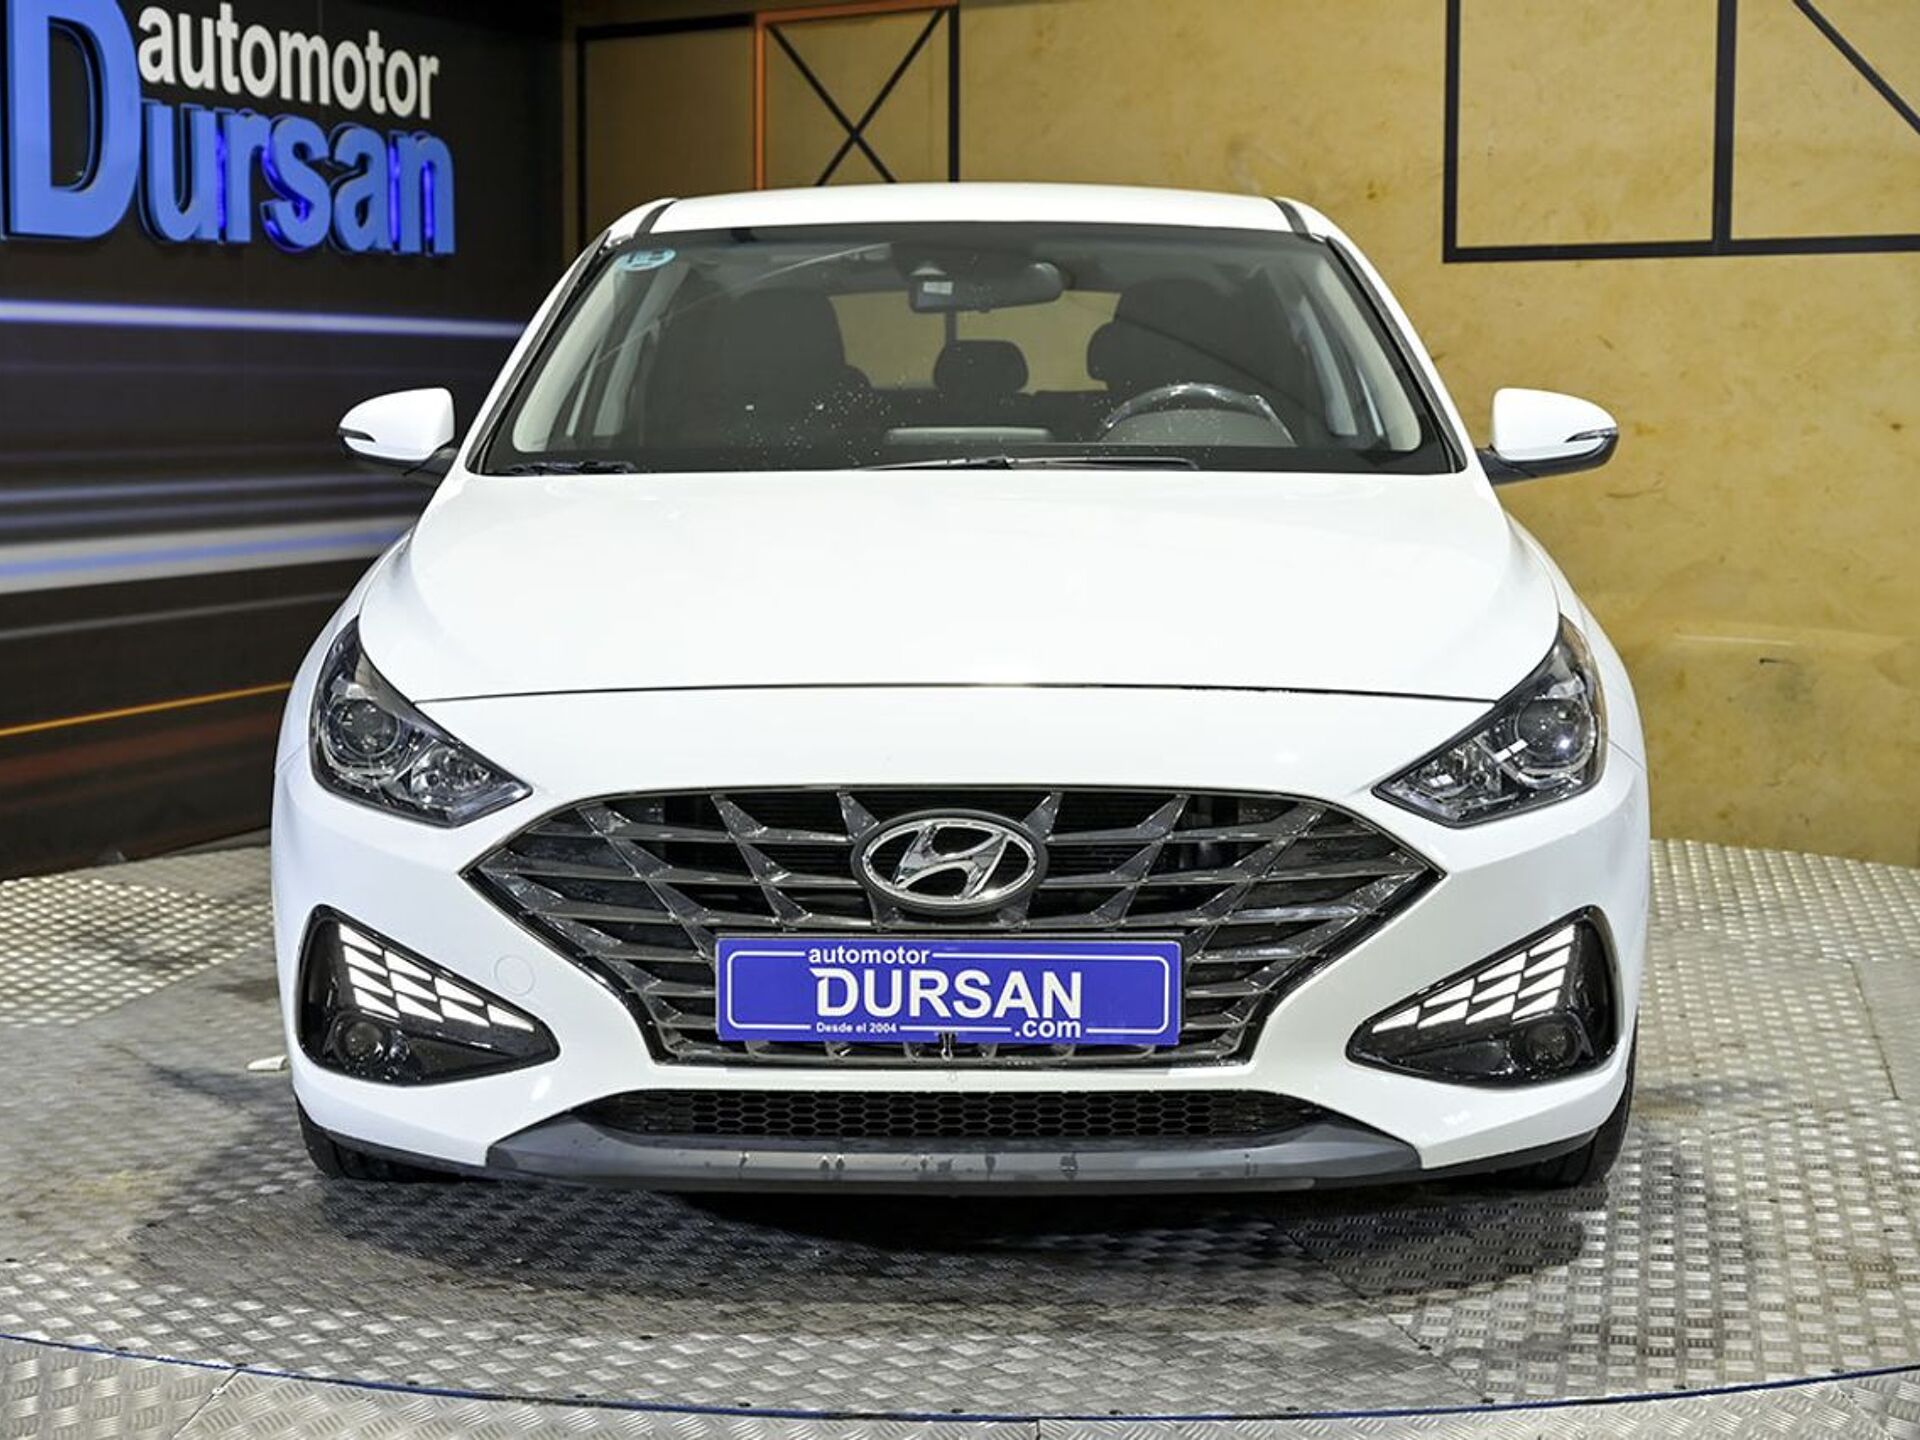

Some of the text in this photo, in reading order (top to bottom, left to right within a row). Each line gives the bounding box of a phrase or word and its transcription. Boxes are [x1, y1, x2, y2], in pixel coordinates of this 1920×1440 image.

[137, 2, 439, 119] automotor
[1, 0, 456, 256] Dursan
[808, 946, 930, 965] automotor
[809, 967, 1082, 1019] DURSAN
[816, 1022, 897, 1033] Desde el 2004
[1014, 1019, 1081, 1039] .com
